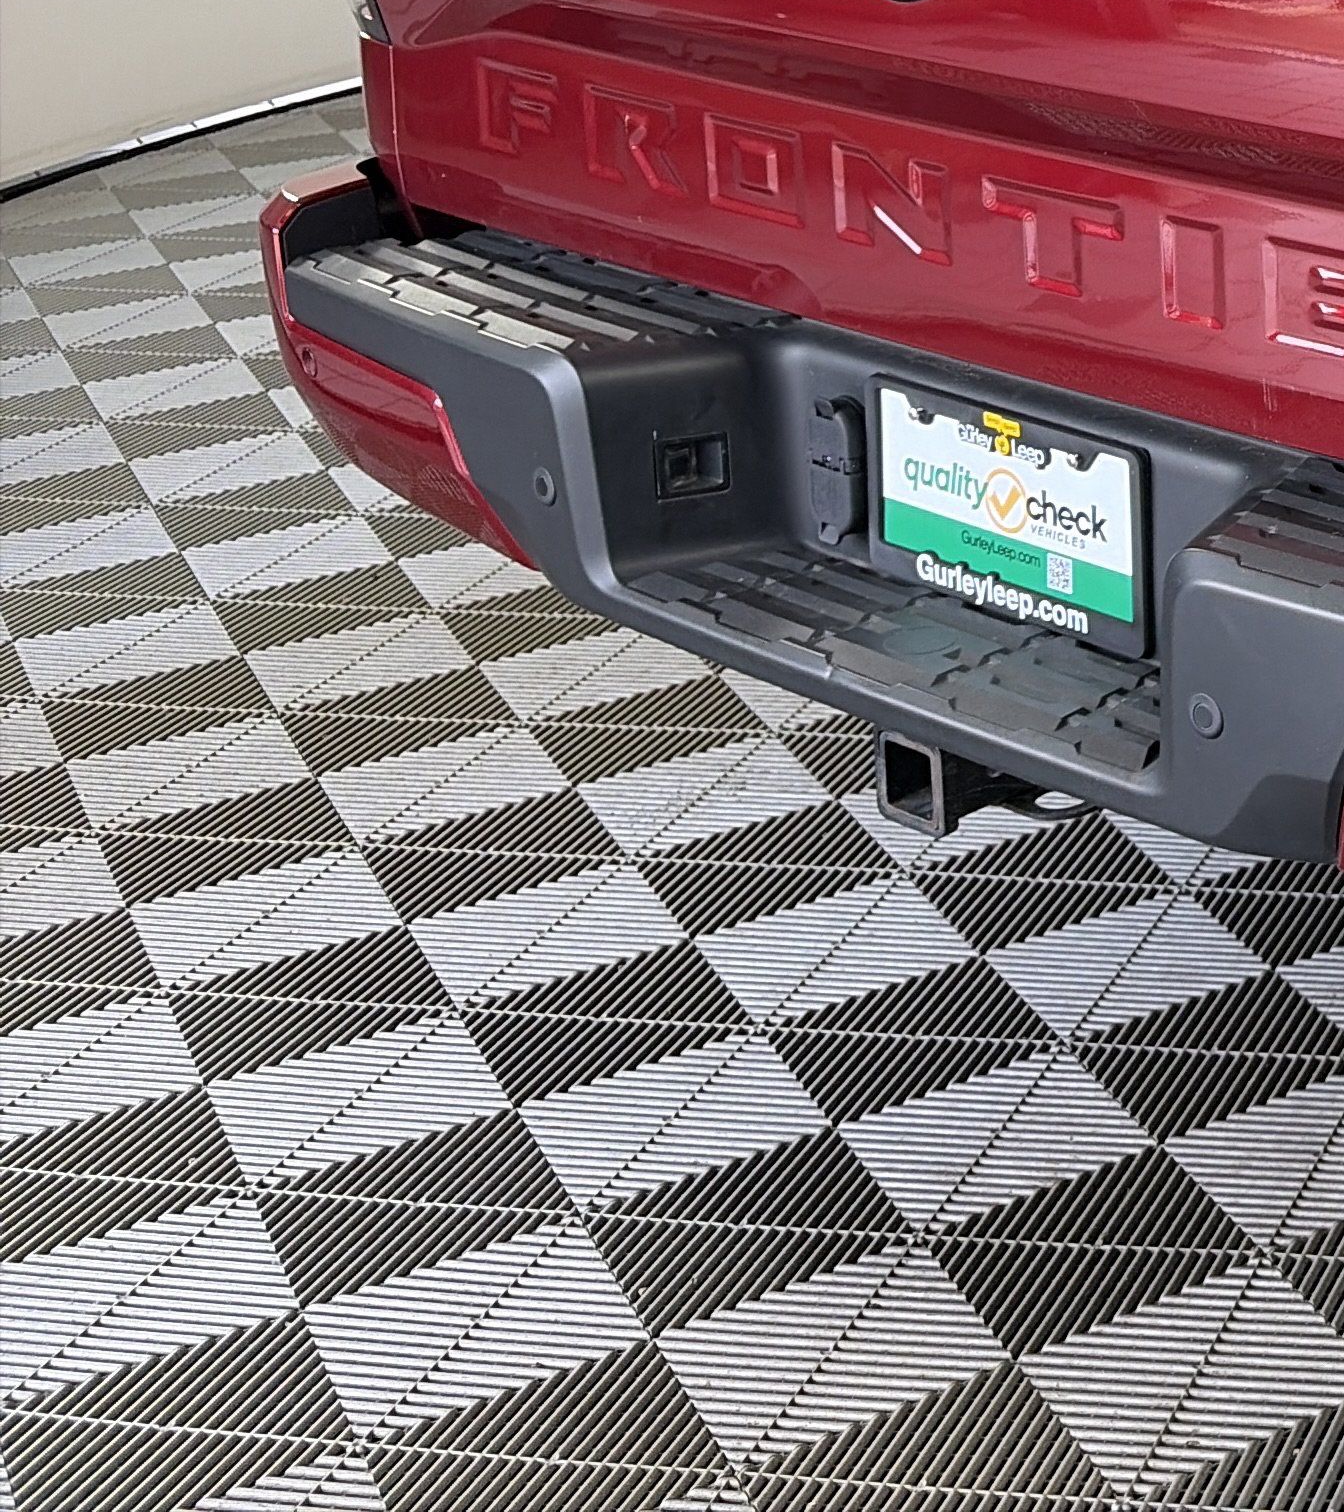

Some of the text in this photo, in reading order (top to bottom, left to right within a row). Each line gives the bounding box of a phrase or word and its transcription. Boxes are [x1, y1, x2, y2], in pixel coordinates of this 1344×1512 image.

[1010, 437, 1045, 466] Leep
[904, 456, 1107, 543] quality check
[961, 530, 1041, 568] GurleyLeep.com
[1031, 524, 1087, 550] VEHICLES
[915, 553, 1089, 635] Gurleyleep.com
